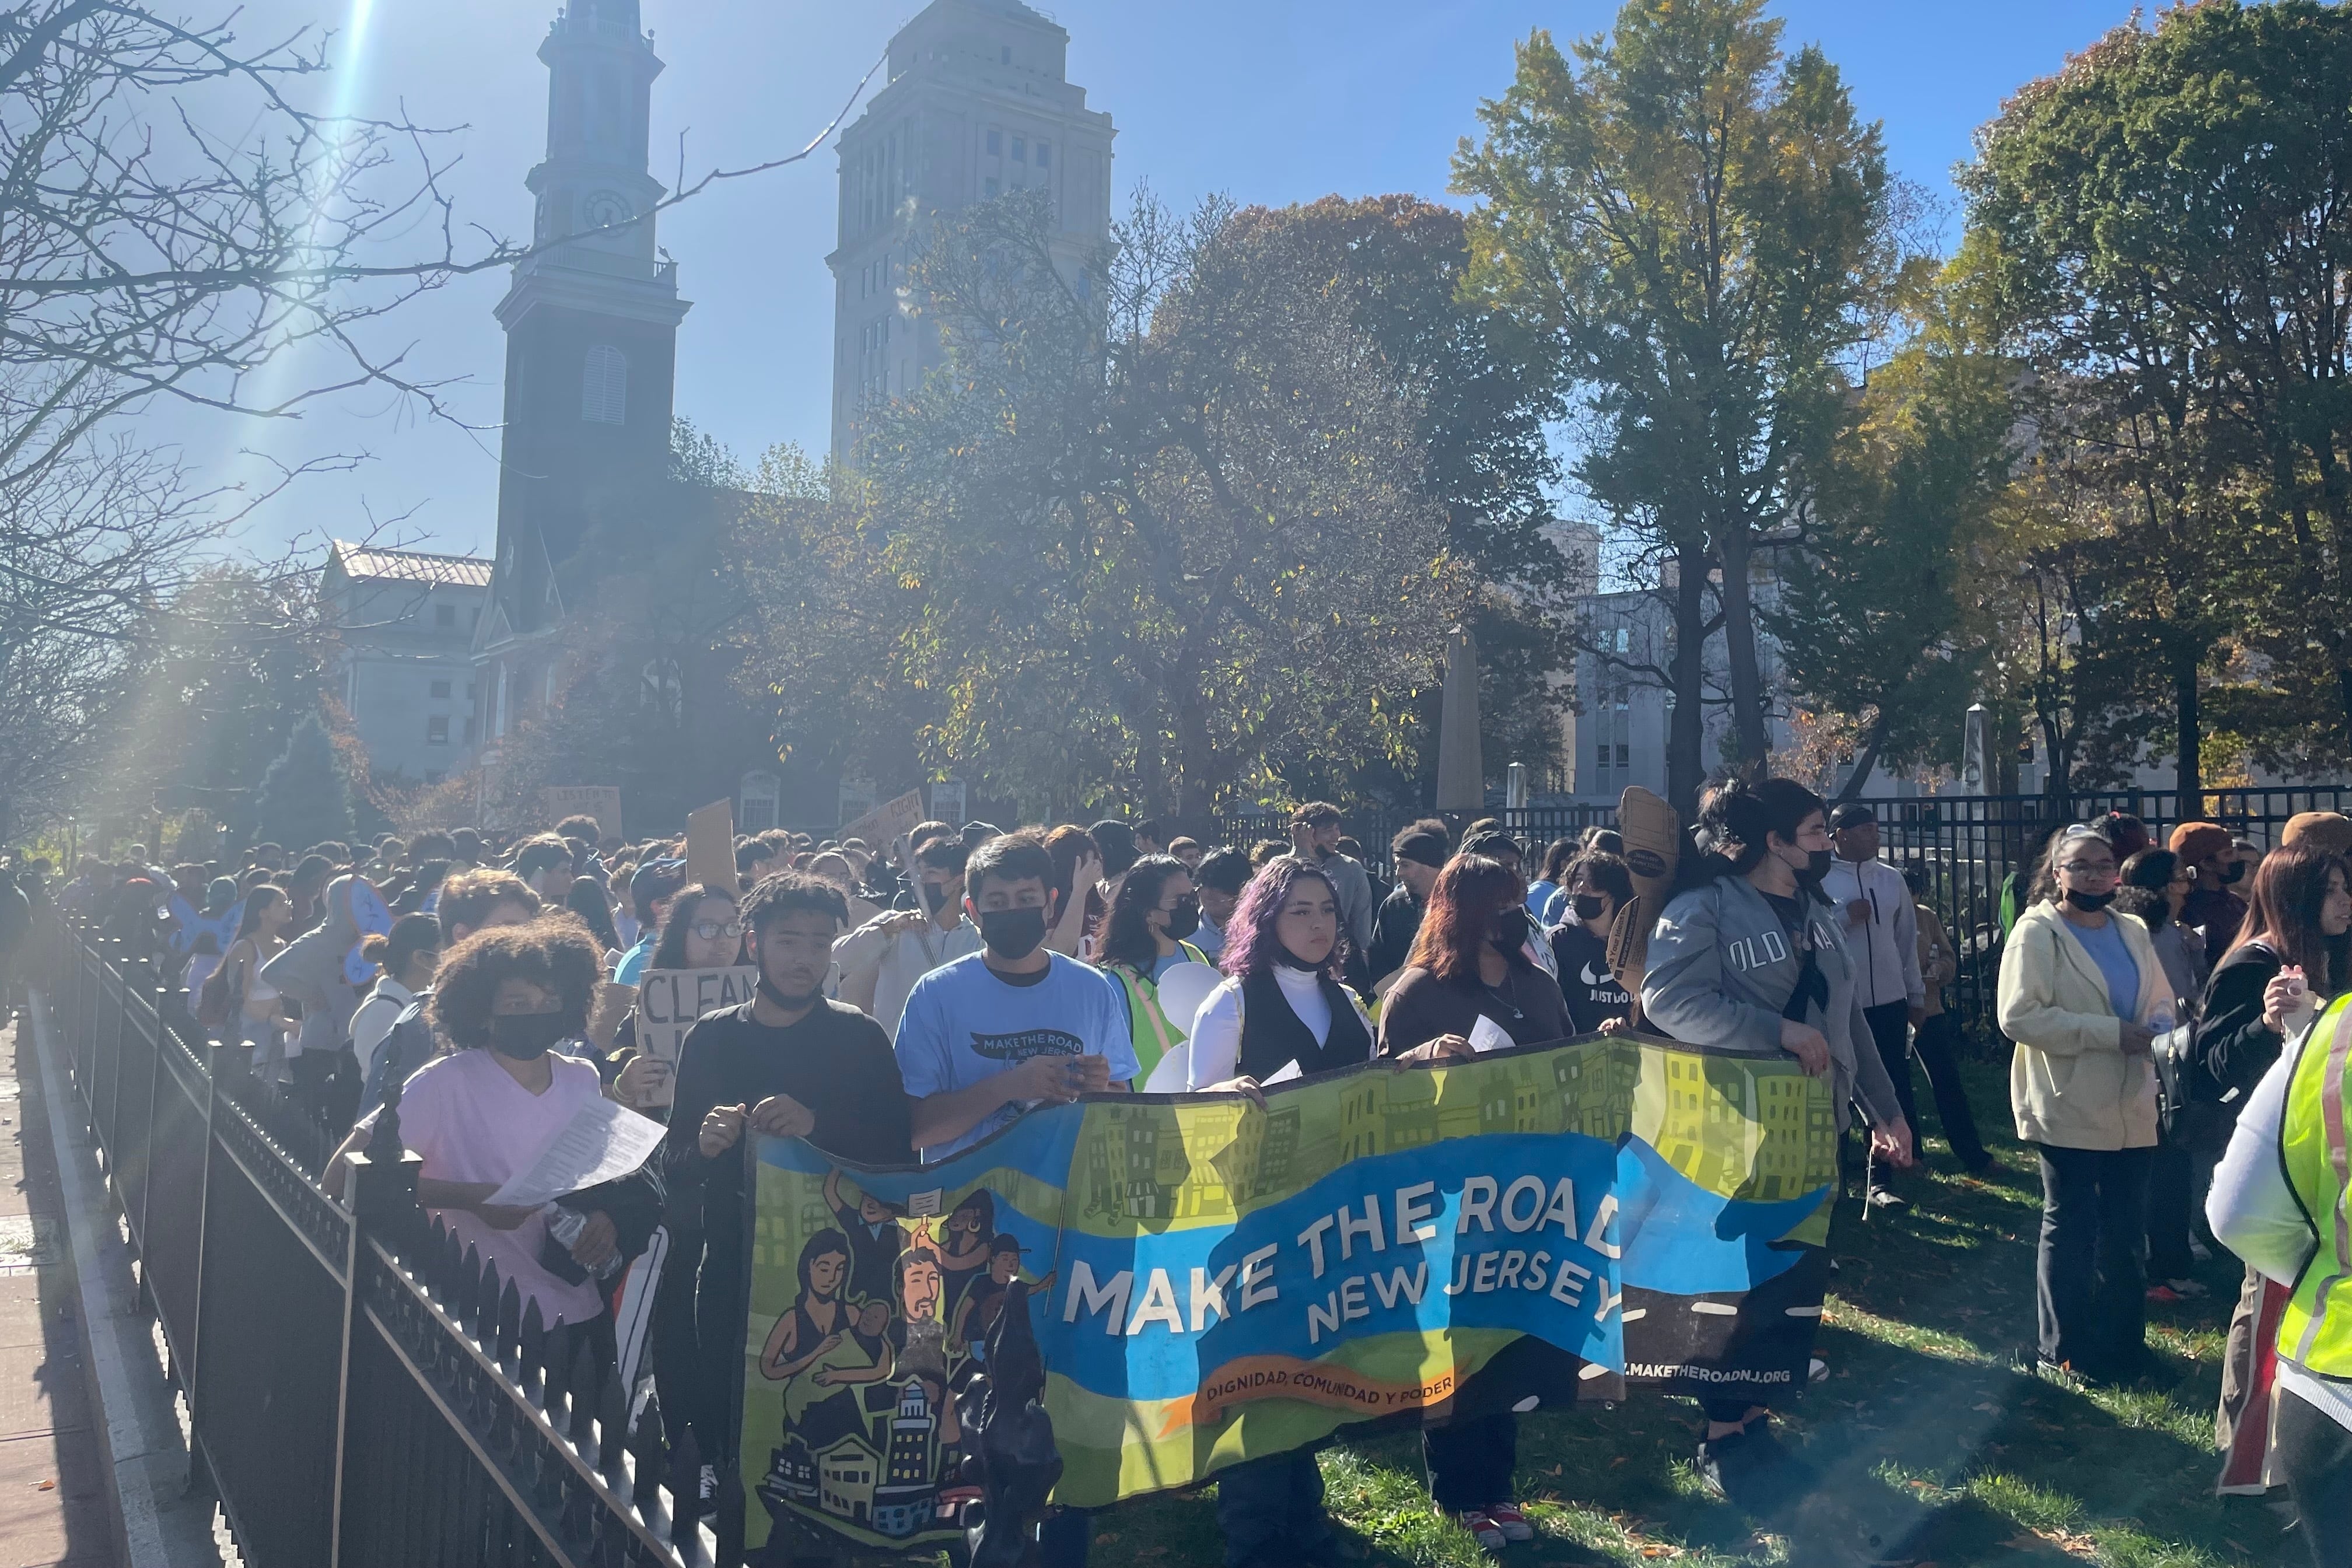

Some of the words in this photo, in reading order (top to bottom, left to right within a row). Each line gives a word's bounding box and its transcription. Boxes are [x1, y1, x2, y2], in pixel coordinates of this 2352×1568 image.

[1729, 931, 1786, 972] OLD
[1590, 989, 1612, 1003] JUST
[984, 1038, 1020, 1049] MAKE
[1020, 1034, 1046, 1046] THE
[1048, 1034, 1082, 1053] ROAD
[1017, 1046, 1038, 1057] NEW
[1062, 1243, 1279, 1336] MAKE
[1297, 1180, 1437, 1279] THE
[1458, 1175, 1621, 1260] ROAD
[1308, 1262, 1427, 1344] NEW
[1444, 1250, 1622, 1323] JERSEY
[1625, 1362, 1791, 1383] .MAKETHEROADNJ.ORG
[1207, 1371, 1287, 1401] DIGNIDAD,
[1386, 1392, 1397, 1405] Y
[1400, 1377, 1452, 1401] PODER
